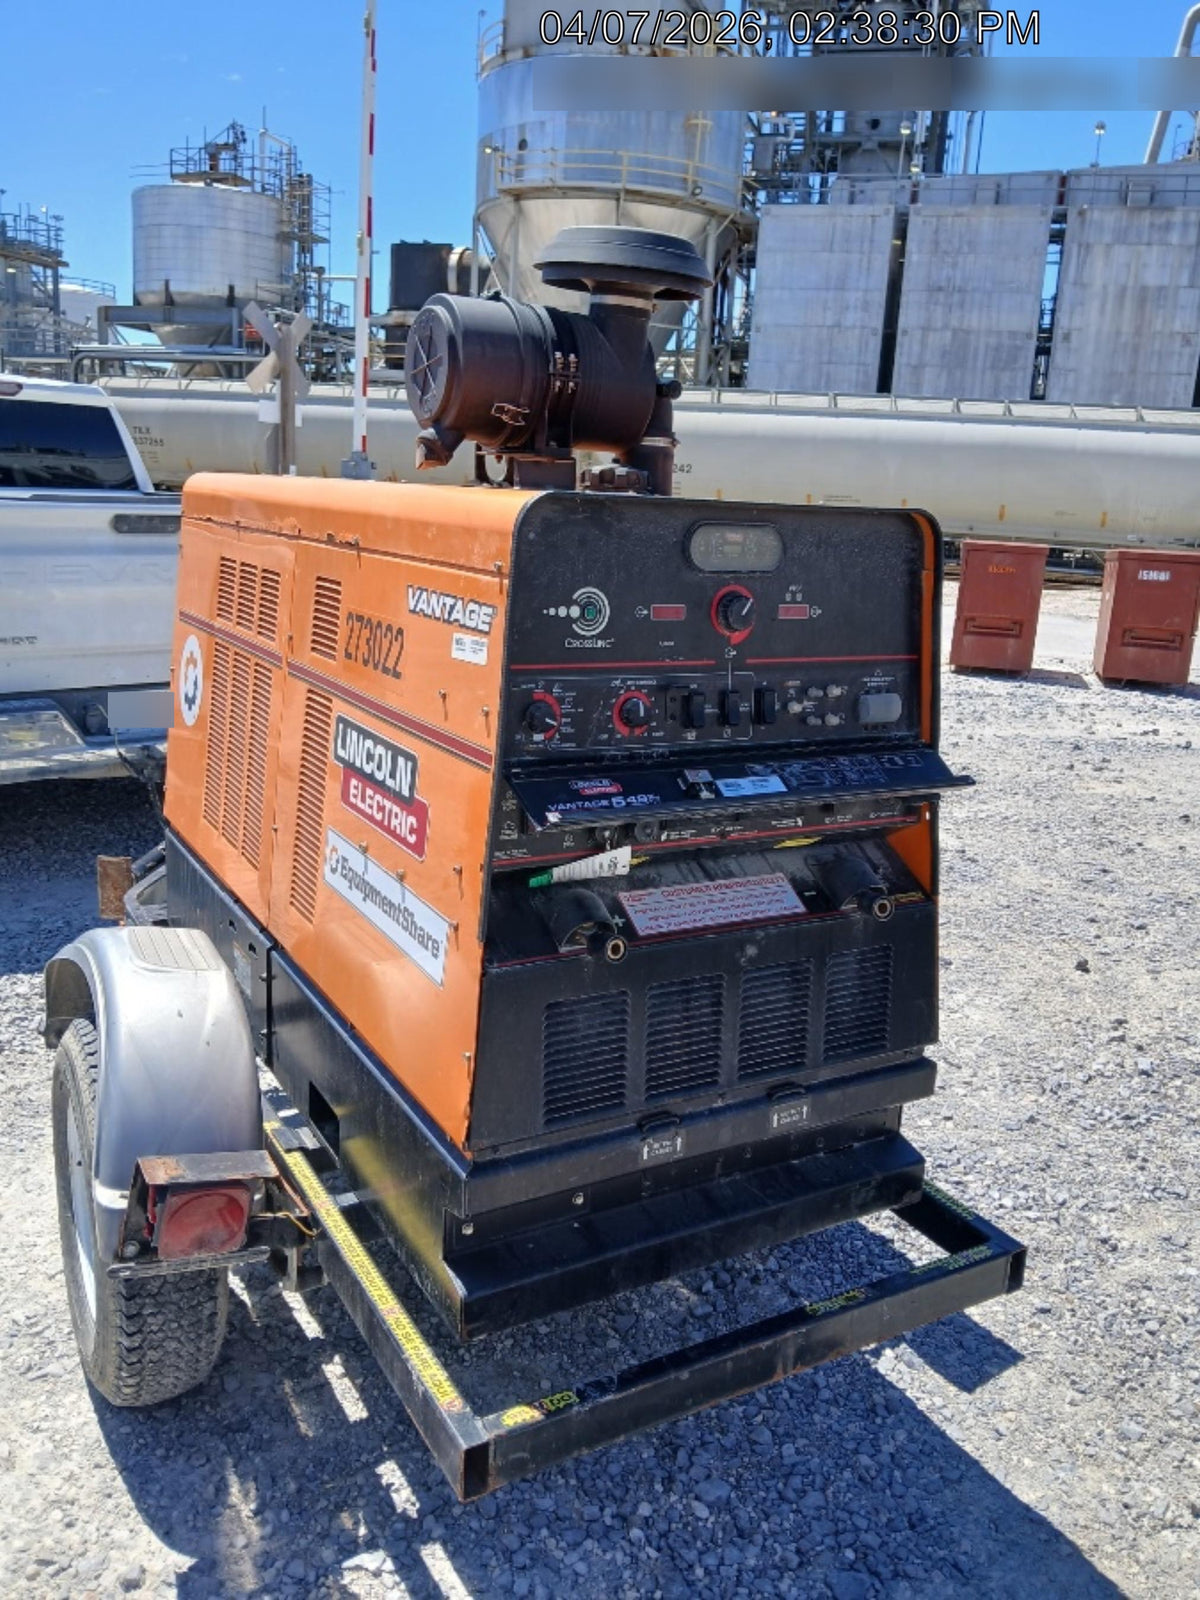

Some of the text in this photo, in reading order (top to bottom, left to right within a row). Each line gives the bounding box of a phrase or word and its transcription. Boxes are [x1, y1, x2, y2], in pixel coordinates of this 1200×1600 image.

[407, 584, 494, 635] VANTAGE
[343, 611, 405, 680] 273022
[337, 722, 413, 798] LINCOLN
[349, 778, 418, 845] ELECTRIC
[340, 855, 443, 960] EquipmentShare
